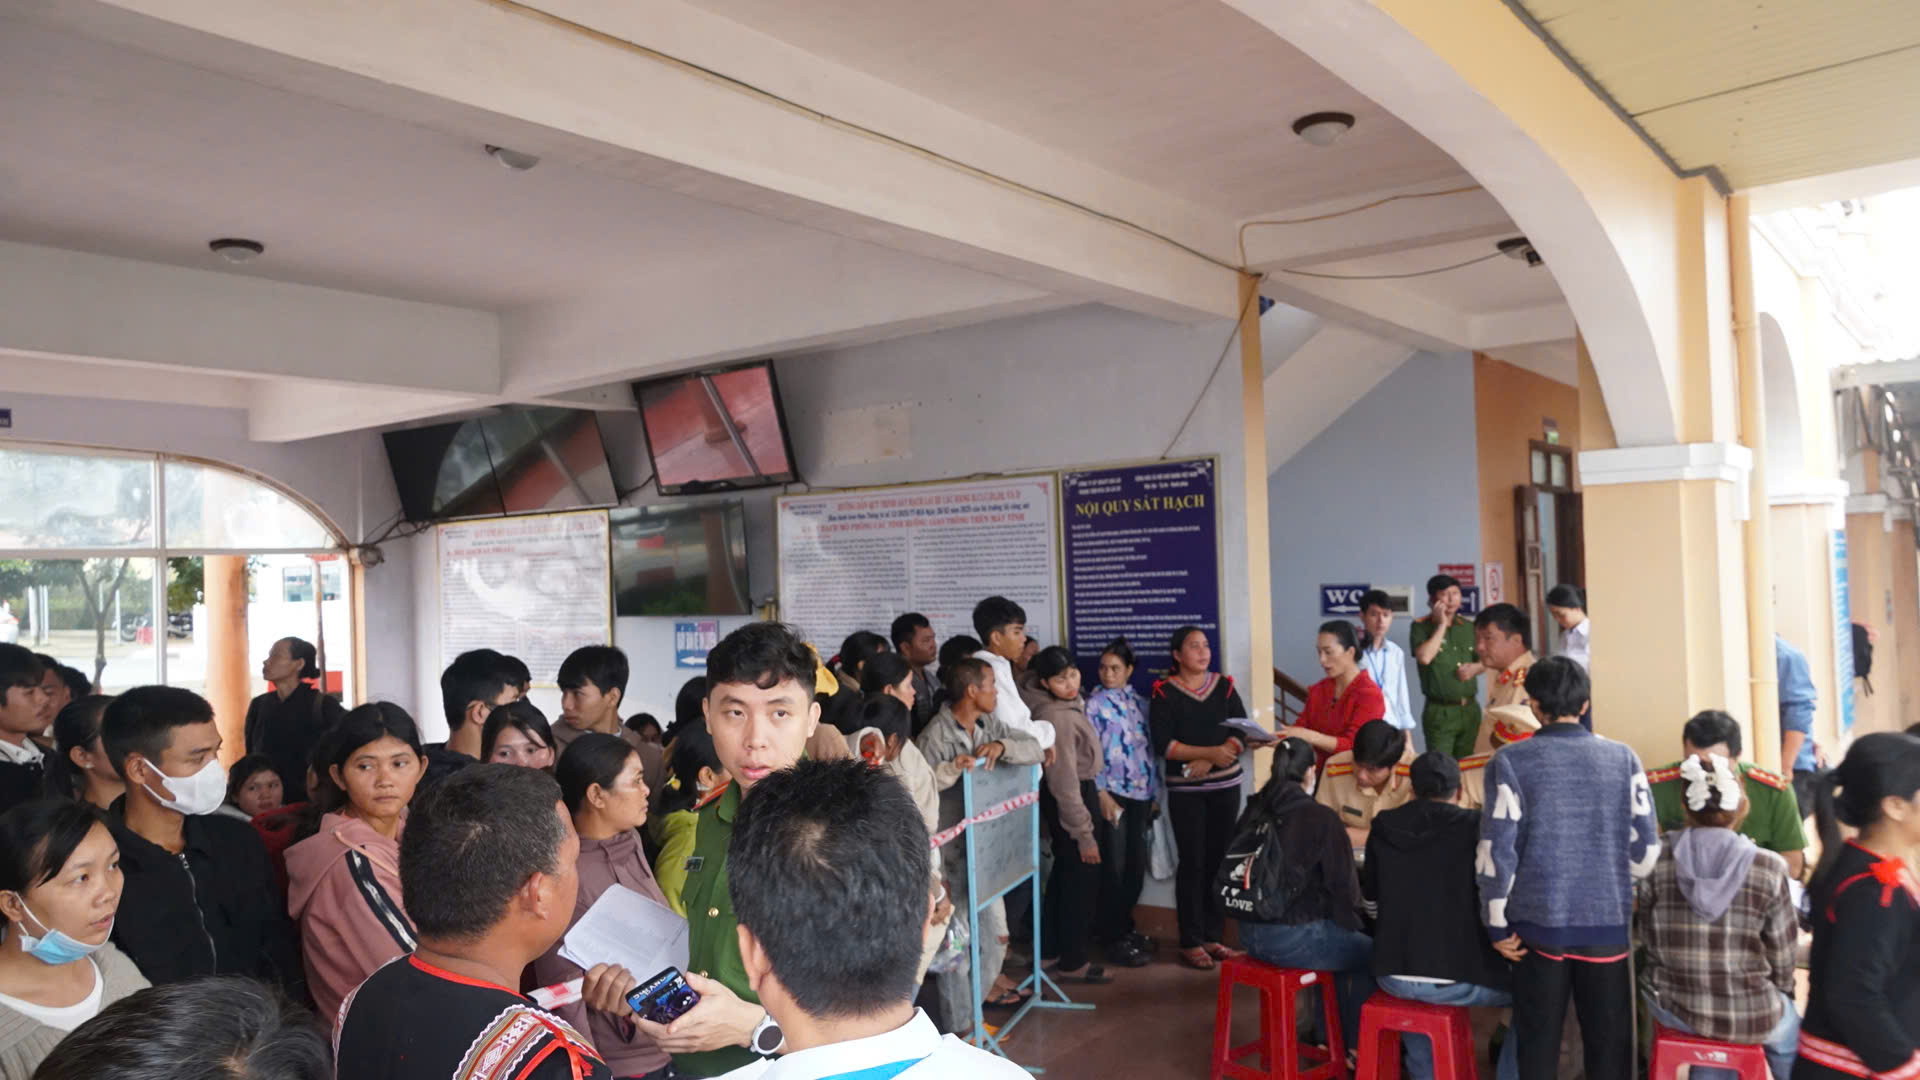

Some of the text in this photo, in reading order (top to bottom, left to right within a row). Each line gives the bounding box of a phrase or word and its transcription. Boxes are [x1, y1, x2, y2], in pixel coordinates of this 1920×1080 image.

[1075, 494, 1205, 518] NỘI QUY SÁT HẠCH
[1326, 589, 1364, 603] WC
[1225, 897, 1254, 912] LOVE
